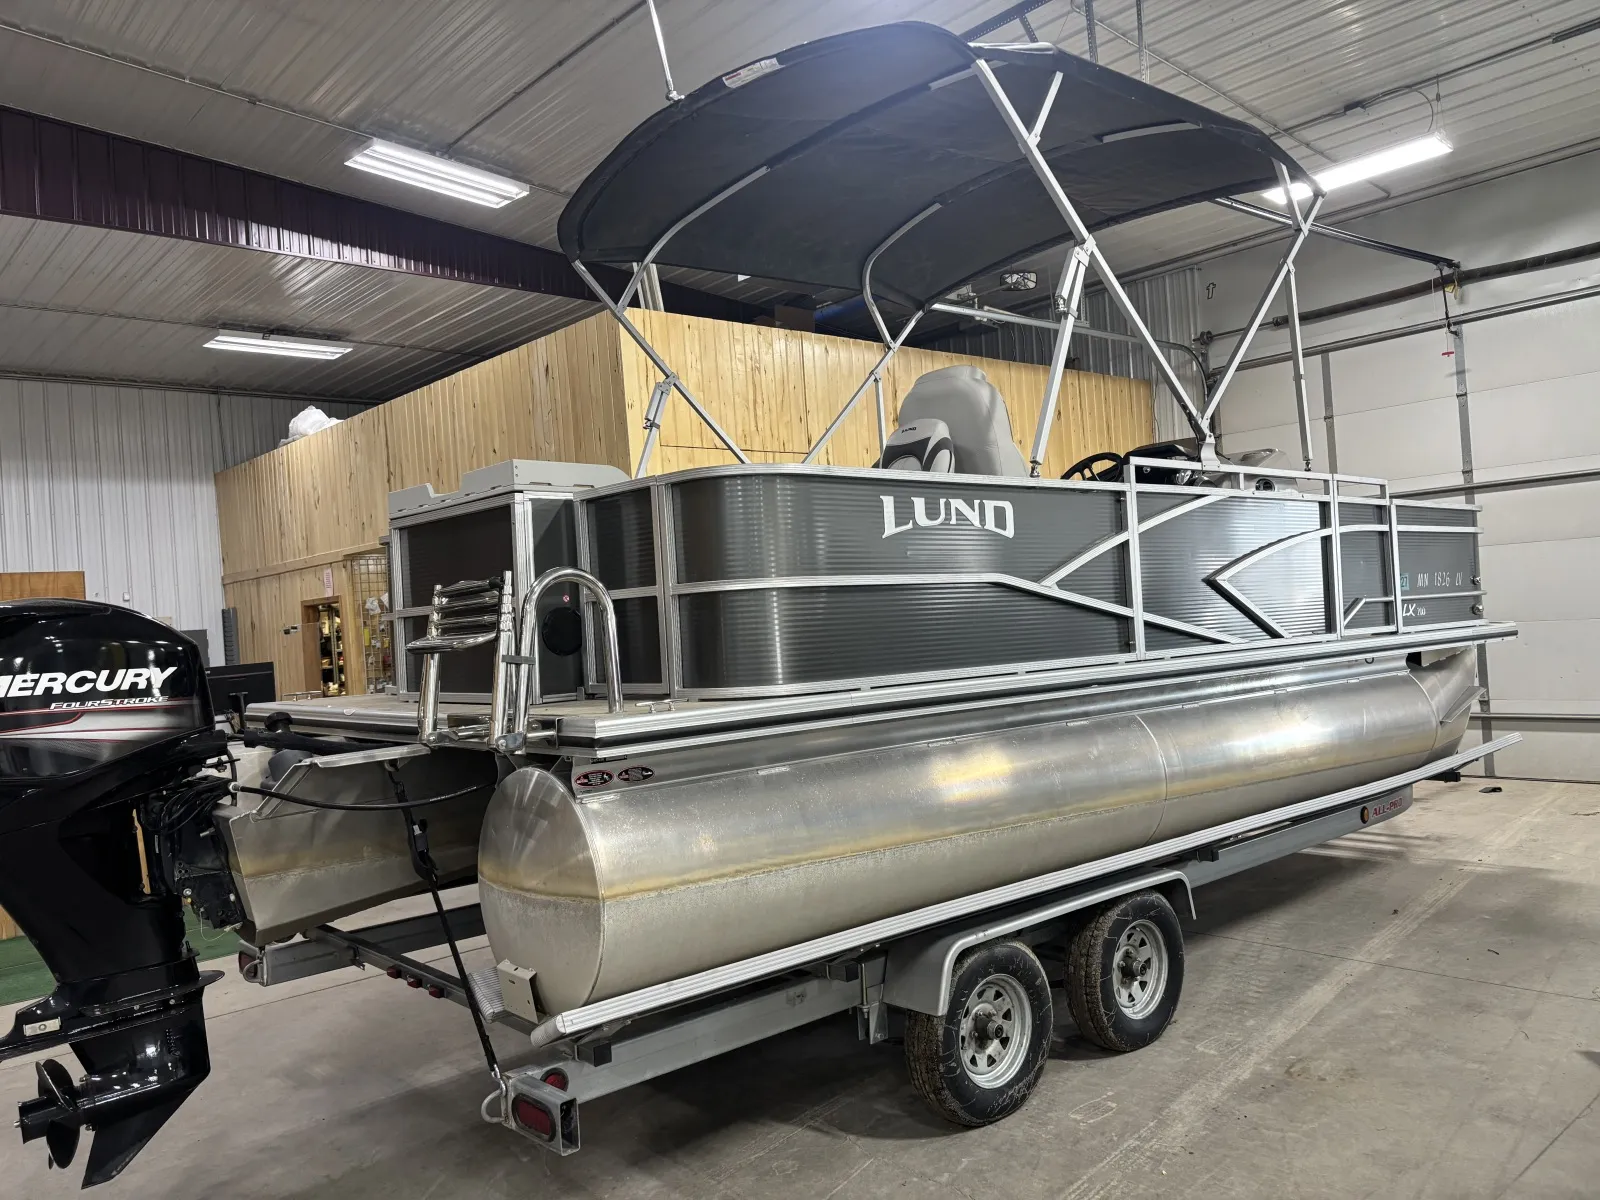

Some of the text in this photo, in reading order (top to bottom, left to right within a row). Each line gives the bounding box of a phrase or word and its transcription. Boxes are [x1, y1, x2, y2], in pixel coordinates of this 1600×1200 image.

[880, 495, 1014, 539] LUND
[1417, 573, 1429, 588] MN
[1403, 604, 1416, 617] LX
[1372, 797, 1403, 817] ALL-PRO
